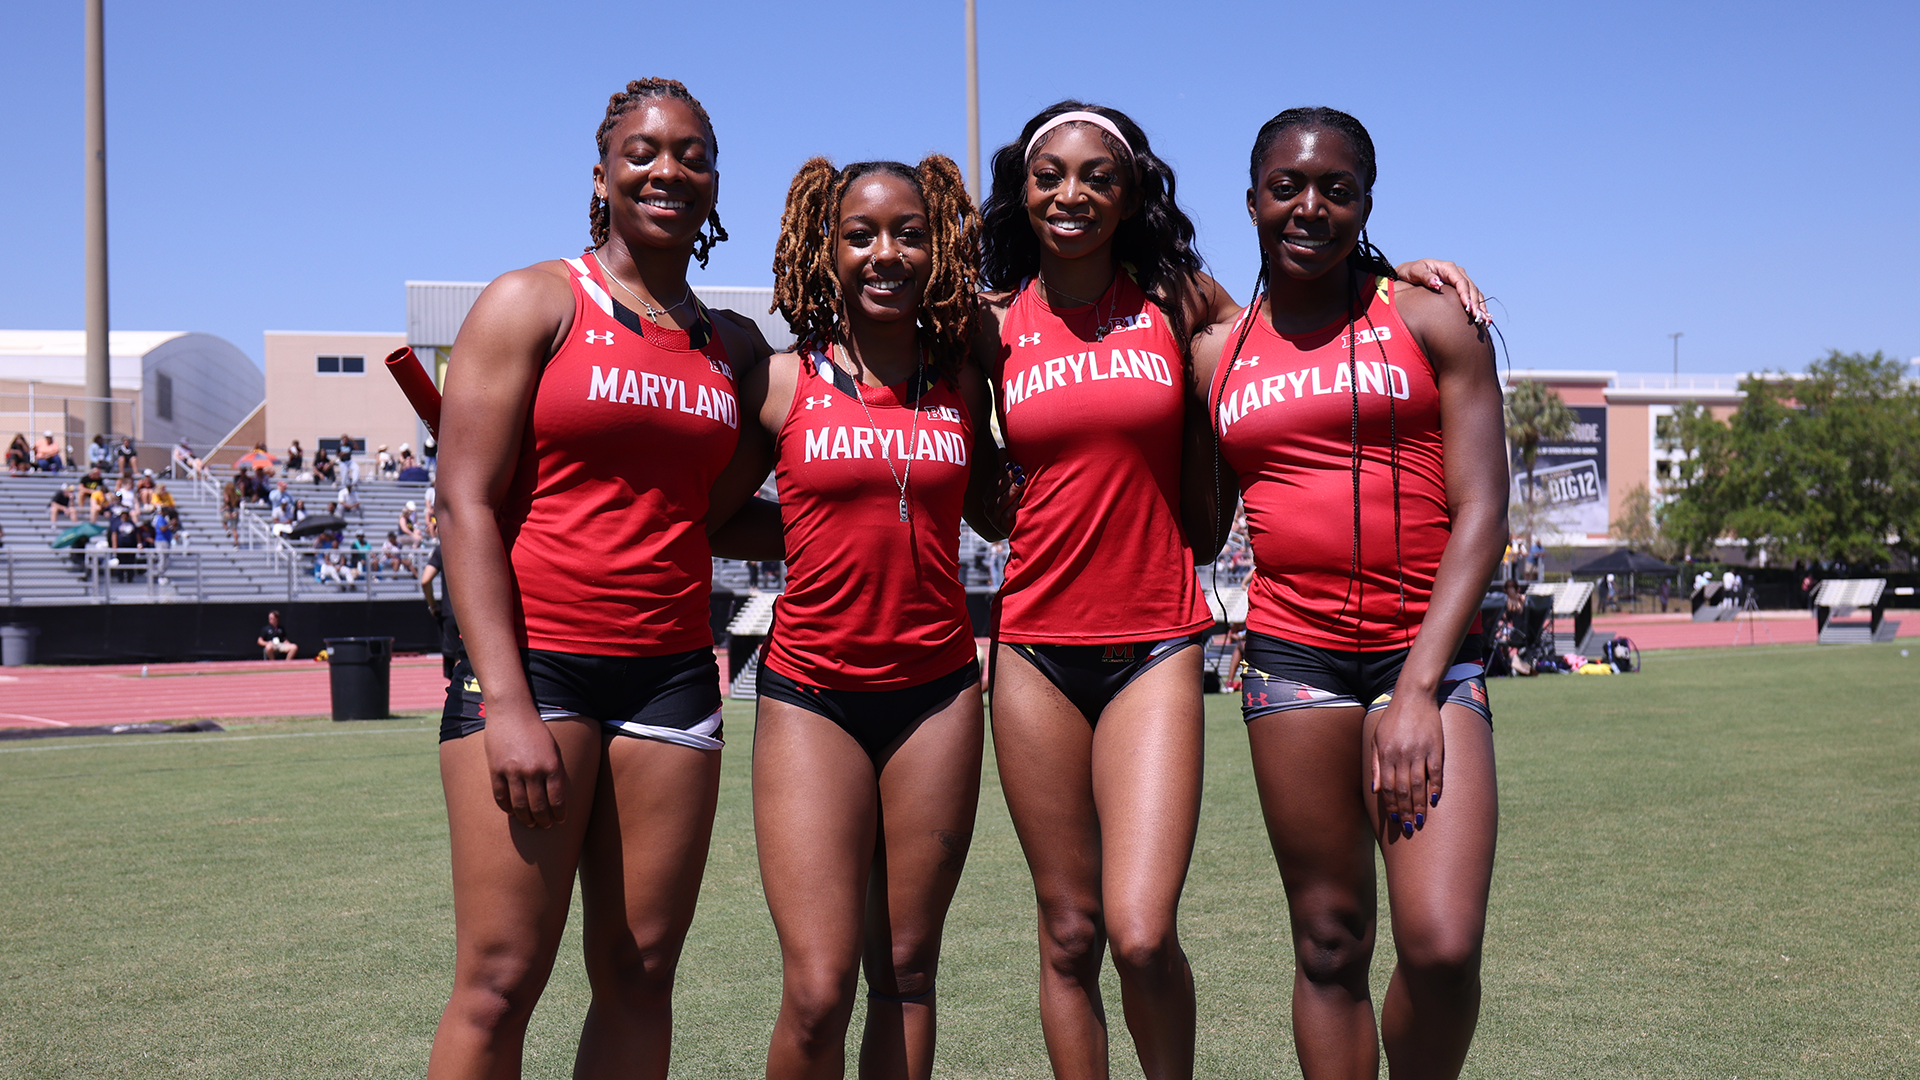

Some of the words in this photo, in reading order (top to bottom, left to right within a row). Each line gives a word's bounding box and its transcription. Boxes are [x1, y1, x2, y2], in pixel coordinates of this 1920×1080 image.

[587, 365, 738, 430] MARYLAND
[1005, 349, 1173, 415] MARYLAND
[1219, 361, 1410, 437] MARYLAND
[804, 426, 967, 467] MARYLAND
